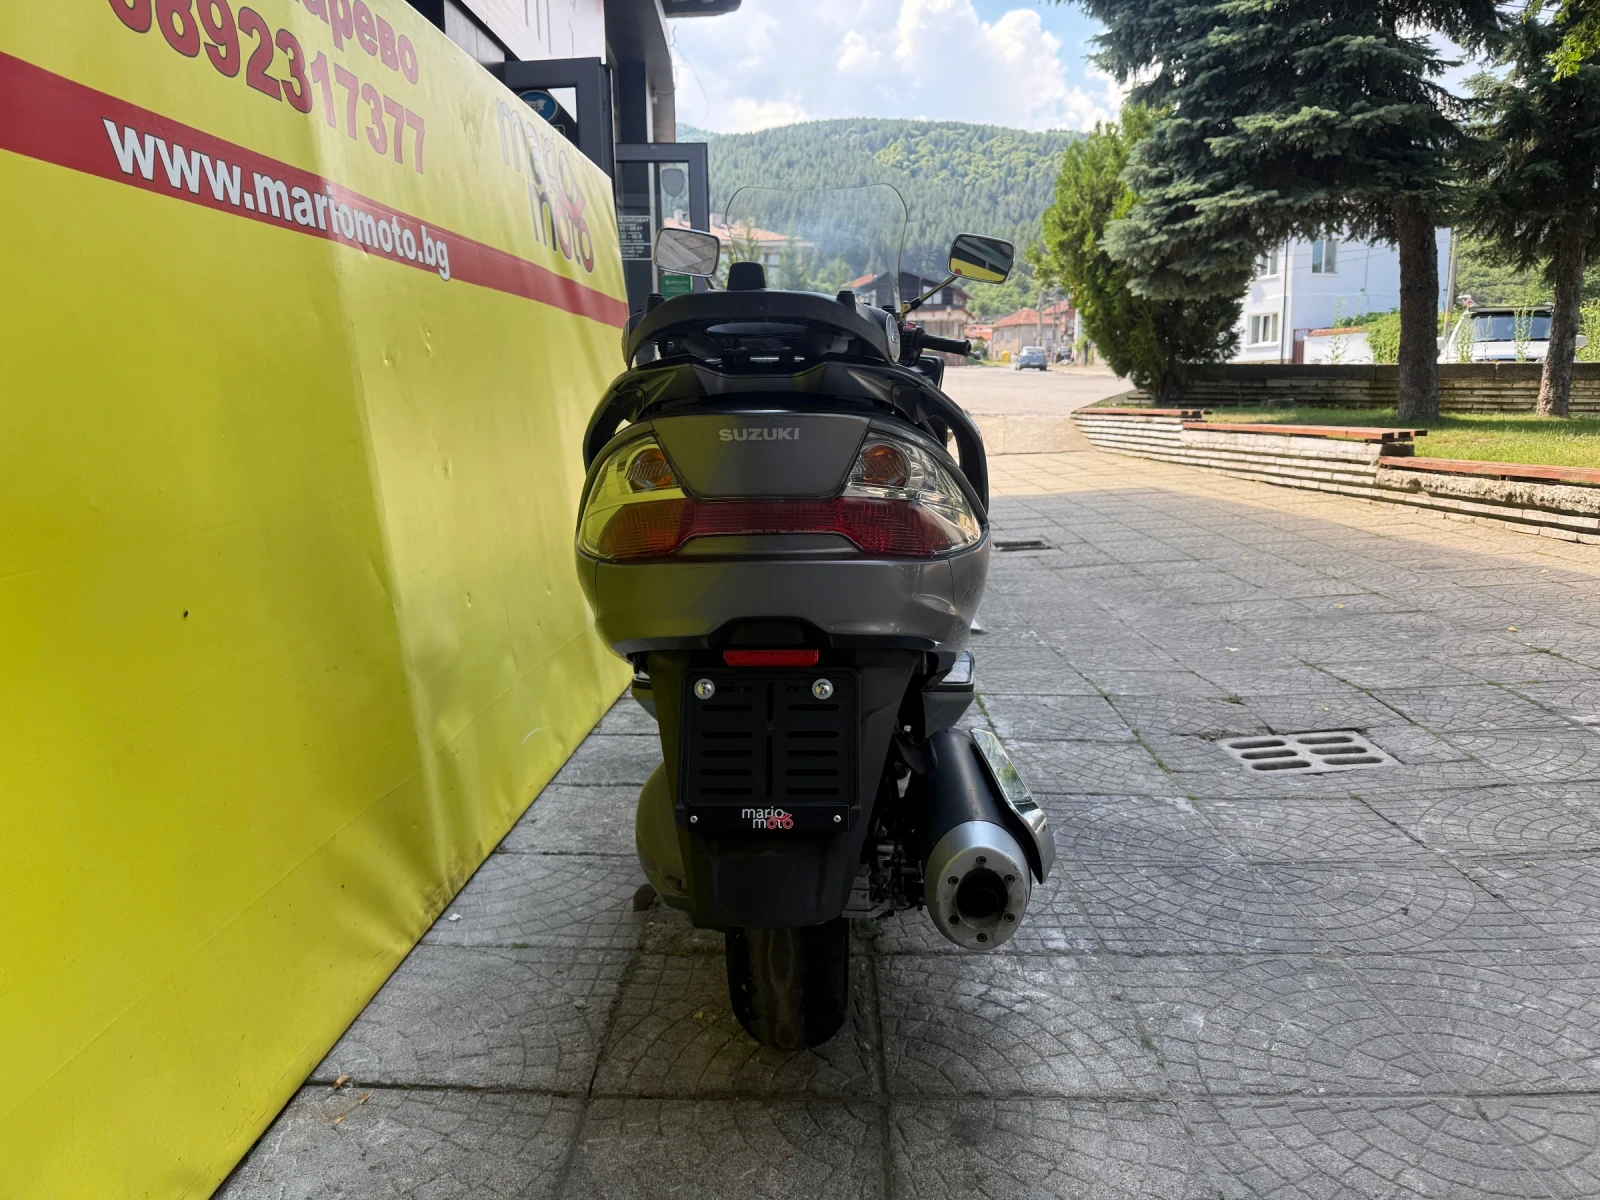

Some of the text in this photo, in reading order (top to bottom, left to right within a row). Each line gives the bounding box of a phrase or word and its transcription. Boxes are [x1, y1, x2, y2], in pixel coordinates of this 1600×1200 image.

[101, 117, 451, 282] www.mariomoto.bg
[718, 427, 800, 442] SUZUKI
[741, 805, 785, 819] mario
[752, 818, 794, 830] moto
